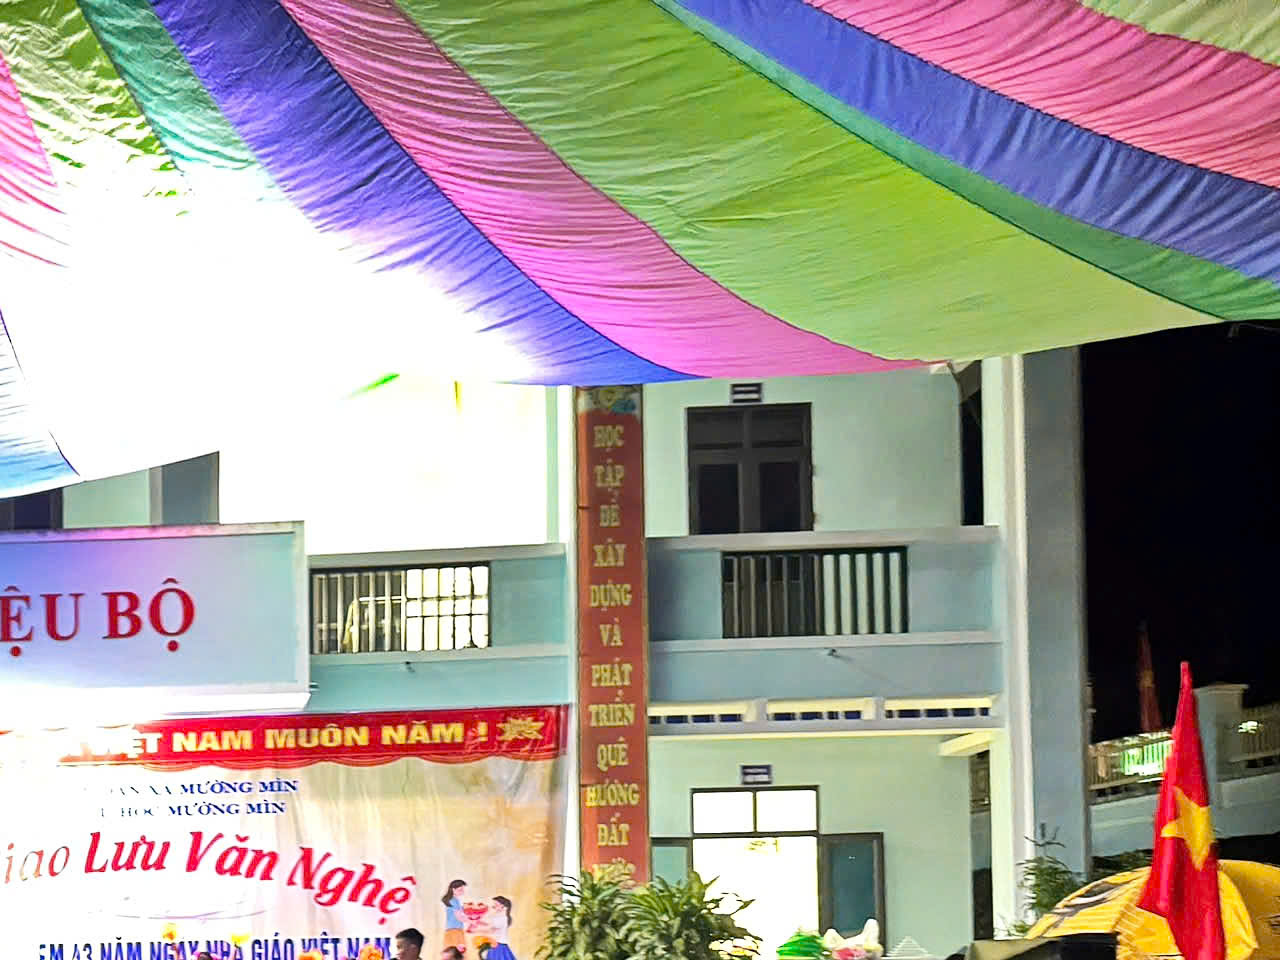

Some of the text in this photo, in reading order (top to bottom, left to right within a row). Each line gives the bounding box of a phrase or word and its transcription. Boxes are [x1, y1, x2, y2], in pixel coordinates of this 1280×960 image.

[593, 537, 626, 567] XÂY
[589, 579, 632, 612] DỰNG
[101, 577, 196, 653] BỘ
[599, 617, 623, 646] VÀ
[591, 657, 632, 687] PHÁT
[588, 689, 635, 727] TRIỂN
[172, 730, 253, 752] NAM
[265, 723, 369, 749] MUÔN
[381, 720, 465, 745] NĂM
[597, 736, 629, 771] QUÊ
[180, 779, 253, 795] MƯỜNG
[258, 777, 299, 793] MÌN
[586, 778, 640, 808] HƯƠNG
[169, 801, 240, 816] MƯỜNG
[246, 799, 286, 814] MÌN
[597, 812, 629, 846] ĐẤT
[84, 831, 171, 874] Lưu
[185, 831, 280, 881] Văn
[286, 846, 417, 925] Nghệ
